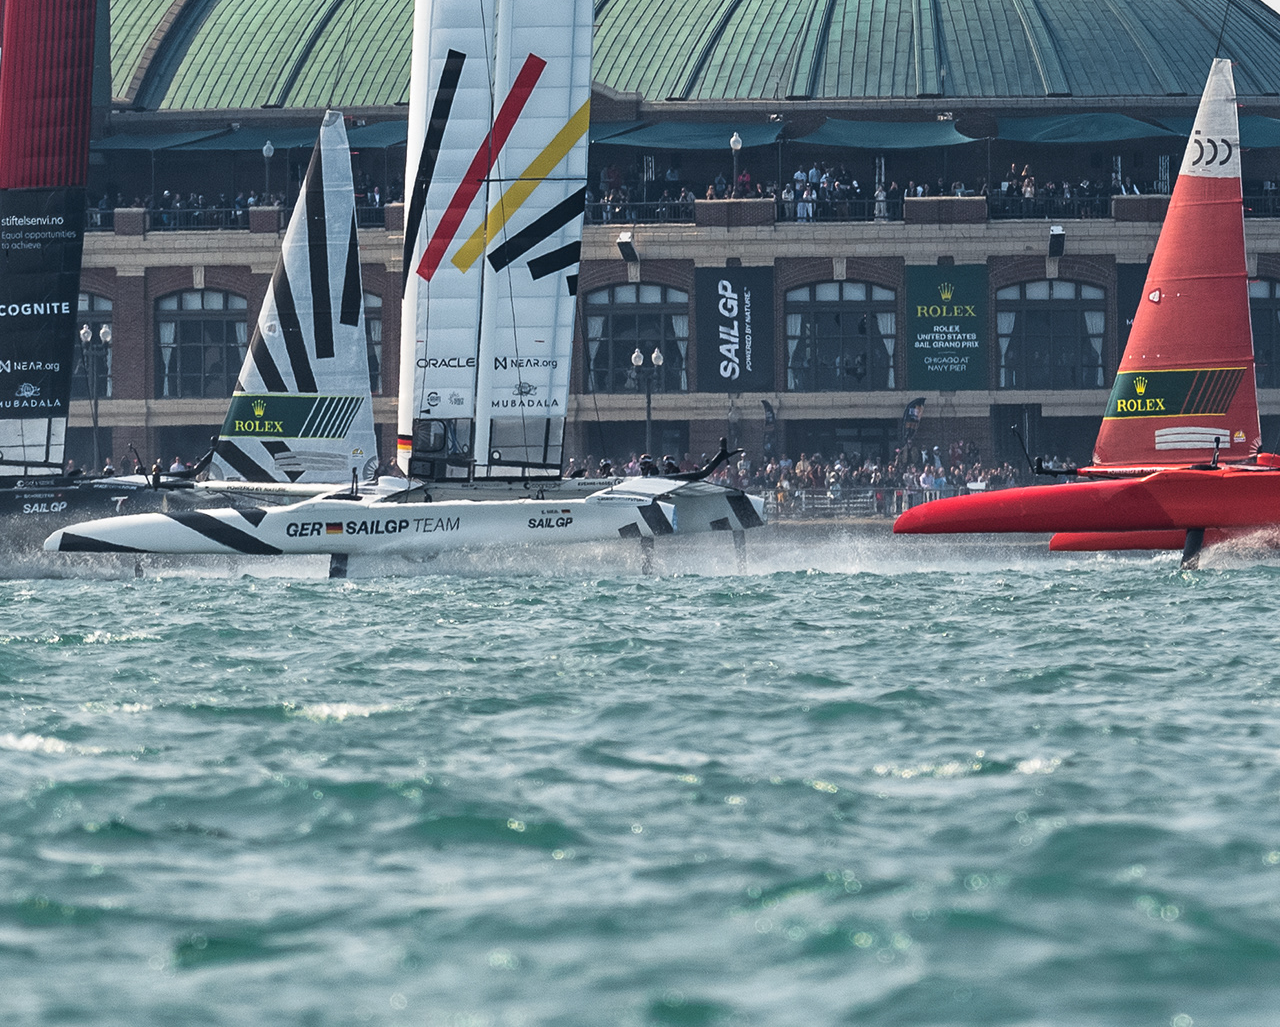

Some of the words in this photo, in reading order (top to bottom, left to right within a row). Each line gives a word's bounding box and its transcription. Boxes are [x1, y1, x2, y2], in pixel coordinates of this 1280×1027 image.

[1, 216, 64, 227] stiftelsenvi.no
[1, 232, 23, 240] Equal
[24, 231, 77, 240] opportunities
[1, 242, 9, 250] to
[11, 242, 42, 250] achieve
[718, 279, 738, 318] GP
[916, 305, 976, 317] ROLEX
[745, 323, 751, 334] BY
[933, 325, 960, 333] ROLEX
[917, 333, 946, 341] UNITED
[947, 333, 977, 341] STATES
[719, 320, 740, 381] SAIL
[914, 341, 931, 349] SAIL
[932, 341, 961, 349] GRAND
[961, 341, 980, 349] PRIX
[13, 362, 60, 372] NEAR.org
[416, 357, 476, 369] ORACLE
[510, 359, 558, 369] NEAR.org
[927, 364, 949, 372] NAVY
[949, 364, 967, 372] PIER
[491, 399, 559, 408] MUBADALA
[1117, 398, 1166, 412] ROLEX
[234, 421, 283, 433] ROLEX
[23, 503, 49, 514] SAIL
[51, 501, 67, 513] GP
[286, 523, 323, 537] GER
[345, 519, 409, 535] SAILGP
[413, 517, 460, 533] TEAM
[528, 518, 555, 529] SAIL
[556, 517, 573, 528] GP
